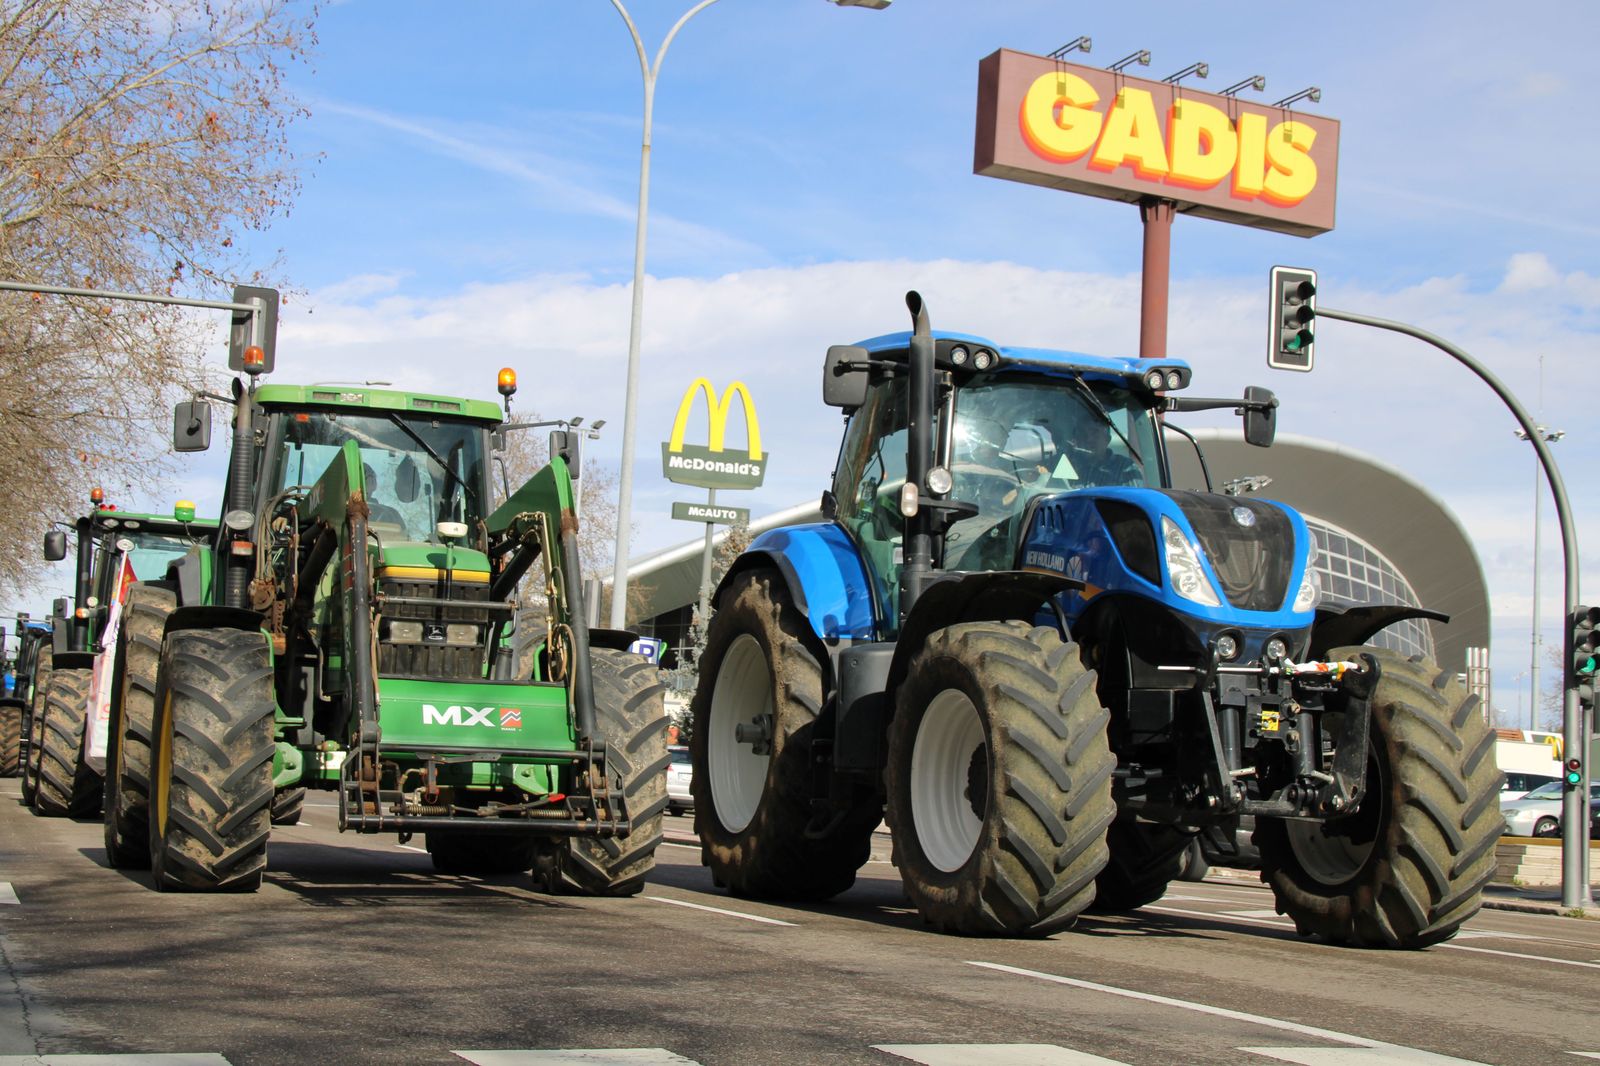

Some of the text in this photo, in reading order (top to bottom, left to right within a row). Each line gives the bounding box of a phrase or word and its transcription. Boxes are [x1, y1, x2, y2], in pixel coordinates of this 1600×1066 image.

[1019, 71, 1317, 208] GADIS
[669, 456, 760, 476] McDonald's
[688, 506, 737, 519] McAUTO
[1037, 552, 1064, 571] HOLLAND
[639, 644, 654, 657] P
[422, 704, 495, 727] MX
